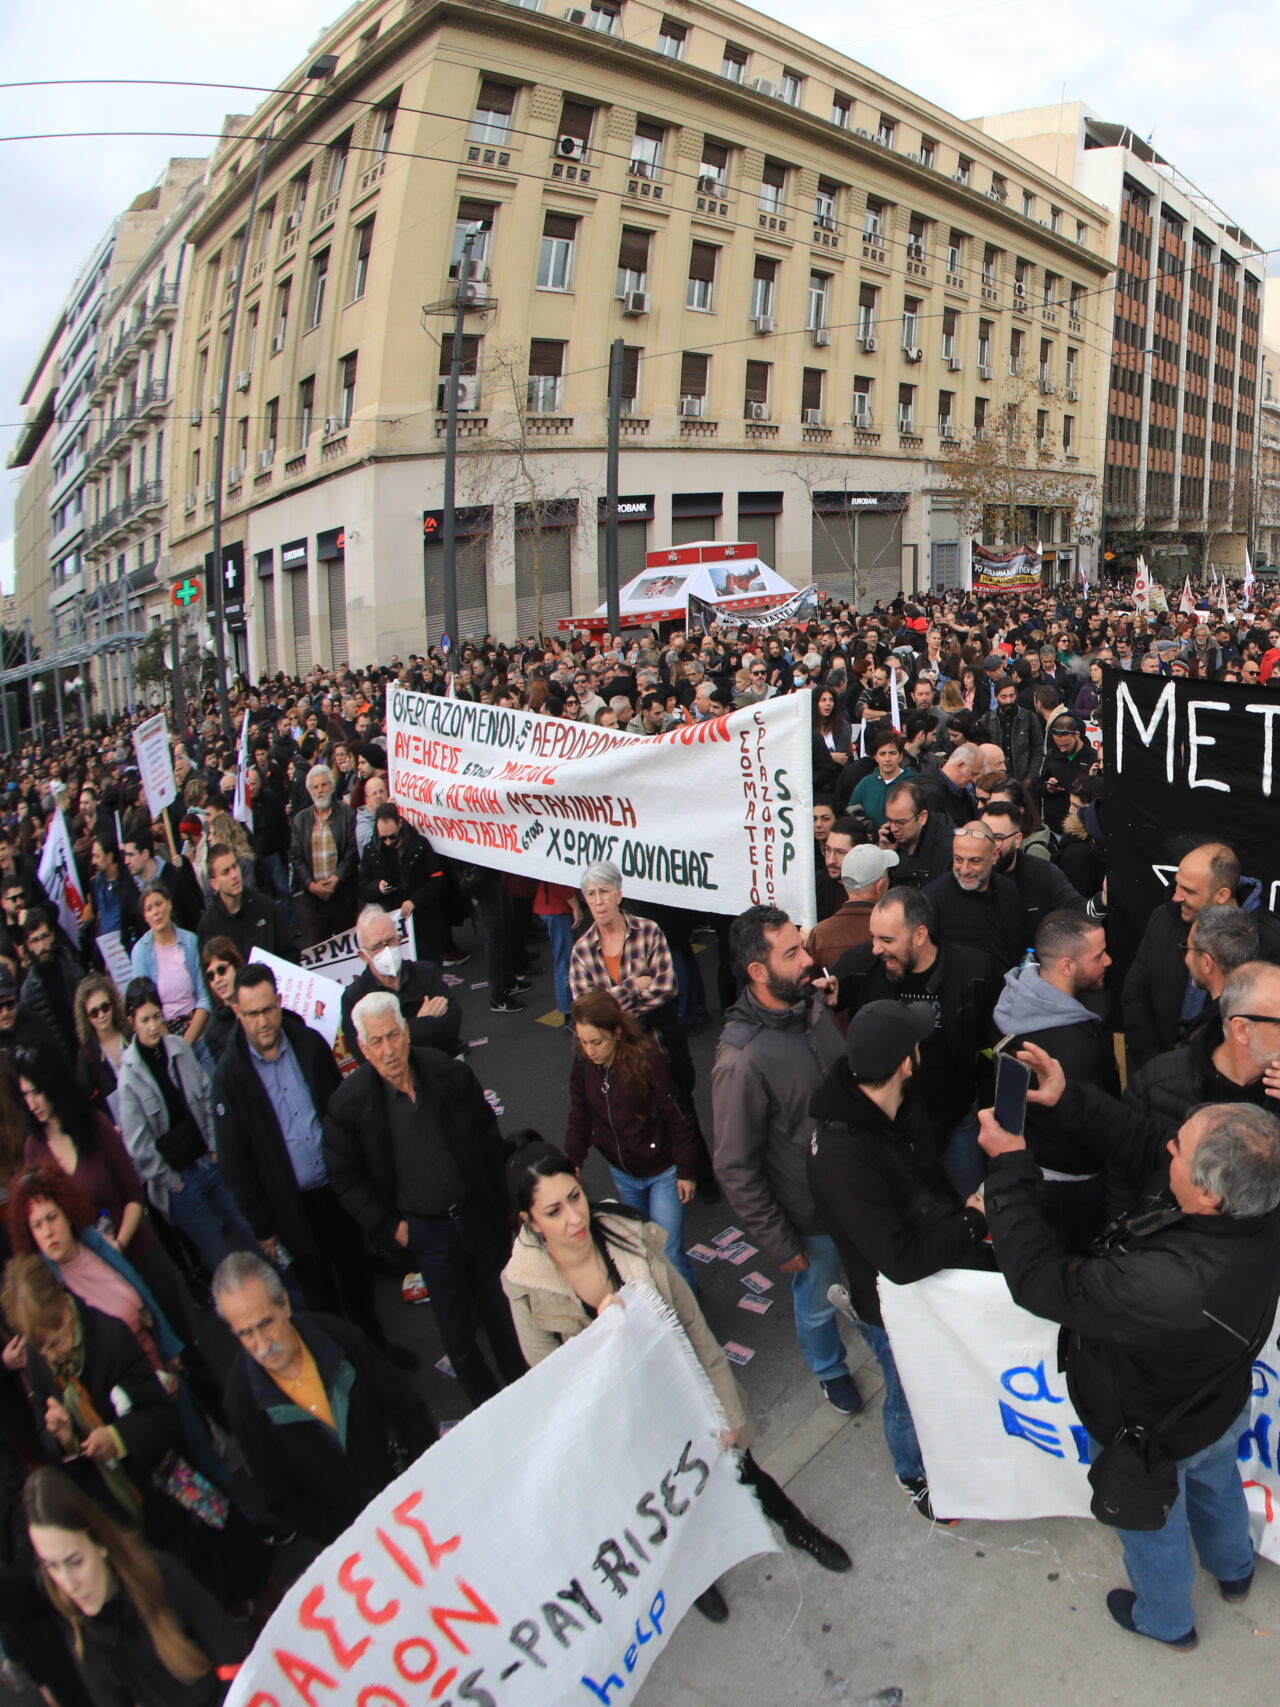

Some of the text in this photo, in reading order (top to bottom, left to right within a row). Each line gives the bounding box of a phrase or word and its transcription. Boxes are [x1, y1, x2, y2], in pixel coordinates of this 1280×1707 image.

[394, 731, 462, 775] ΑΥΞΗΣΕΙΣ
[506, 791, 637, 829] ΜΕΤΑΚΙΝΗΣΗ
[433, 814, 523, 854] ΠΡΟΣΤΑΣΙΑΣ
[546, 826, 619, 866] ΧΩΡΟΥΣ
[621, 839, 719, 890] ΔΟΥΛΕΙΑΣ
[592, 1439, 711, 1599] RISES
[246, 1489, 462, 1707] ΑΣΕΙΣ
